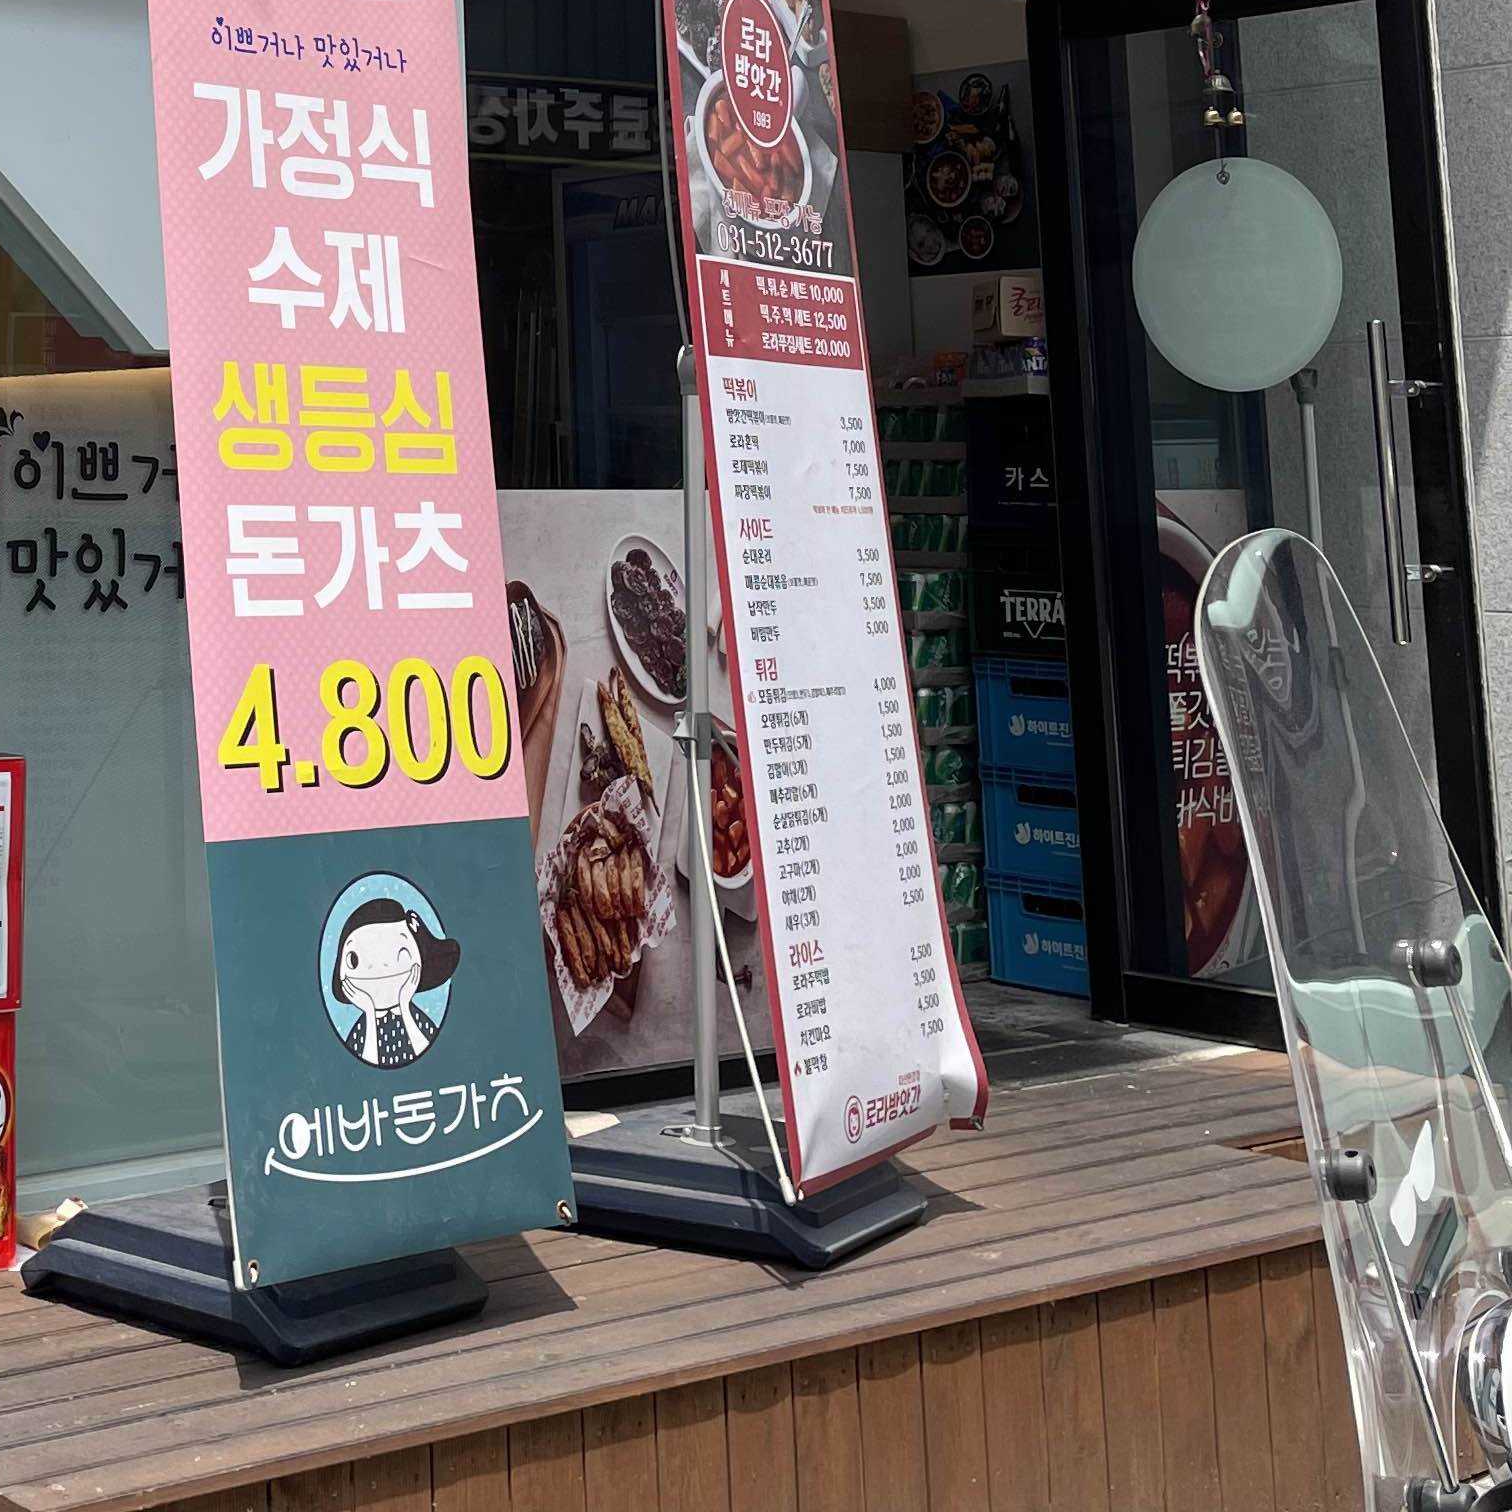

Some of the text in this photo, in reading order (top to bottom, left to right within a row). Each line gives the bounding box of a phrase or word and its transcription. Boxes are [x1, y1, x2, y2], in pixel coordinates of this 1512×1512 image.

[211, 19, 407, 73] 이쁘거나 맛있거나
[740, 16, 773, 64] 로라
[734, 52, 783, 104] 방앗간
[753, 109, 772, 130] 1983
[193, 82, 436, 209] 가정식
[721, 188, 823, 235] 전메뉴 포장 가능
[717, 221, 834, 269] 031-512-3677
[248, 226, 406, 334] 수제
[790, 281, 809, 300] 세트
[809, 284, 844, 305] 10,000
[794, 308, 813, 327] 세트
[813, 311, 847, 332] 12,500
[814, 338, 851, 358] 20.000
[722, 377, 758, 402] 떡볶이
[213, 360, 459, 475] 생등심
[840, 416, 863, 432] 3,500
[842, 439, 866, 455] 7,000
[845, 463, 869, 478] 7,500
[1004, 465, 1050, 491] 카스
[848, 486, 872, 501] 7,500
[740, 517, 774, 541] 사이드
[225, 500, 474, 618] 돈가츠
[857, 548, 880, 564] 3,500
[859, 572, 883, 588] 7,500
[863, 596, 886, 611] 3,500
[1000, 593, 1065, 626] TERRA
[866, 620, 889, 637] 5,000
[754, 657, 778, 682] 튀김
[873, 677, 896, 693] 4,000
[878, 699, 899, 717] 1,500
[217, 653, 512, 794] 4.800
[881, 723, 902, 740] 1,500
[884, 746, 906, 763] 1,500
[886, 769, 909, 787] 2,000
[889, 793, 912, 810] 2,000
[892, 816, 915, 834] 2,000
[896, 840, 918, 859] 2,000
[899, 864, 921, 883] 2,000
[902, 887, 924, 907] 2,500
[788, 938, 825, 969] 라이스
[910, 943, 932, 964] 2,500
[913, 967, 936, 988] 3,500
[800, 992, 940, 1047] 치킨마요 4,500
[920, 1017, 944, 1039] 7,500
[865, 1083, 921, 1129] 로라방앗간
